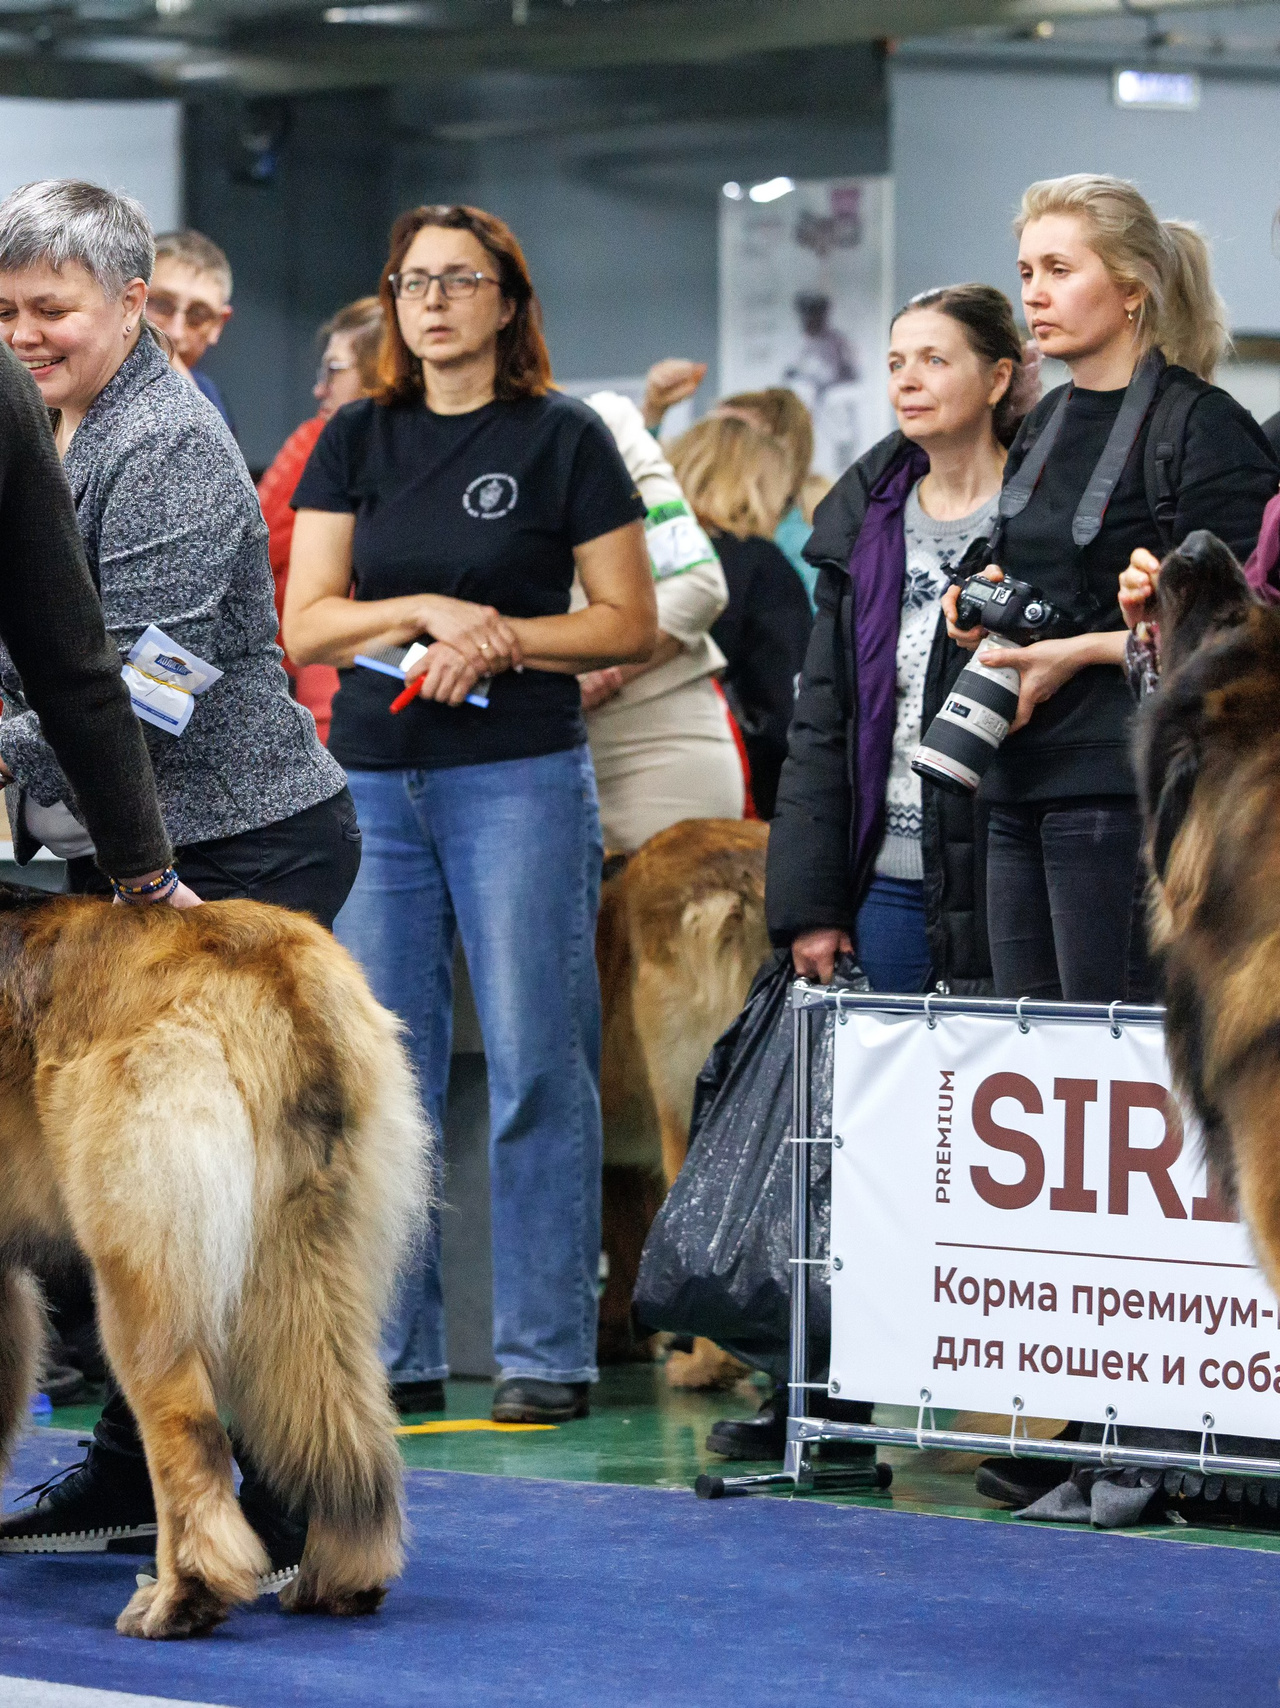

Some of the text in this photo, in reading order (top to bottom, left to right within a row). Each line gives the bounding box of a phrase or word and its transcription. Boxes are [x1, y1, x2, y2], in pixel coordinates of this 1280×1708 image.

[935, 1070, 956, 1205] PREMIUM
[934, 1266, 1280, 1336] Корма премиум-
[933, 1336, 1005, 1372] для
[1020, 1344, 1150, 1384] кошек
[1163, 1355, 1186, 1387] и
